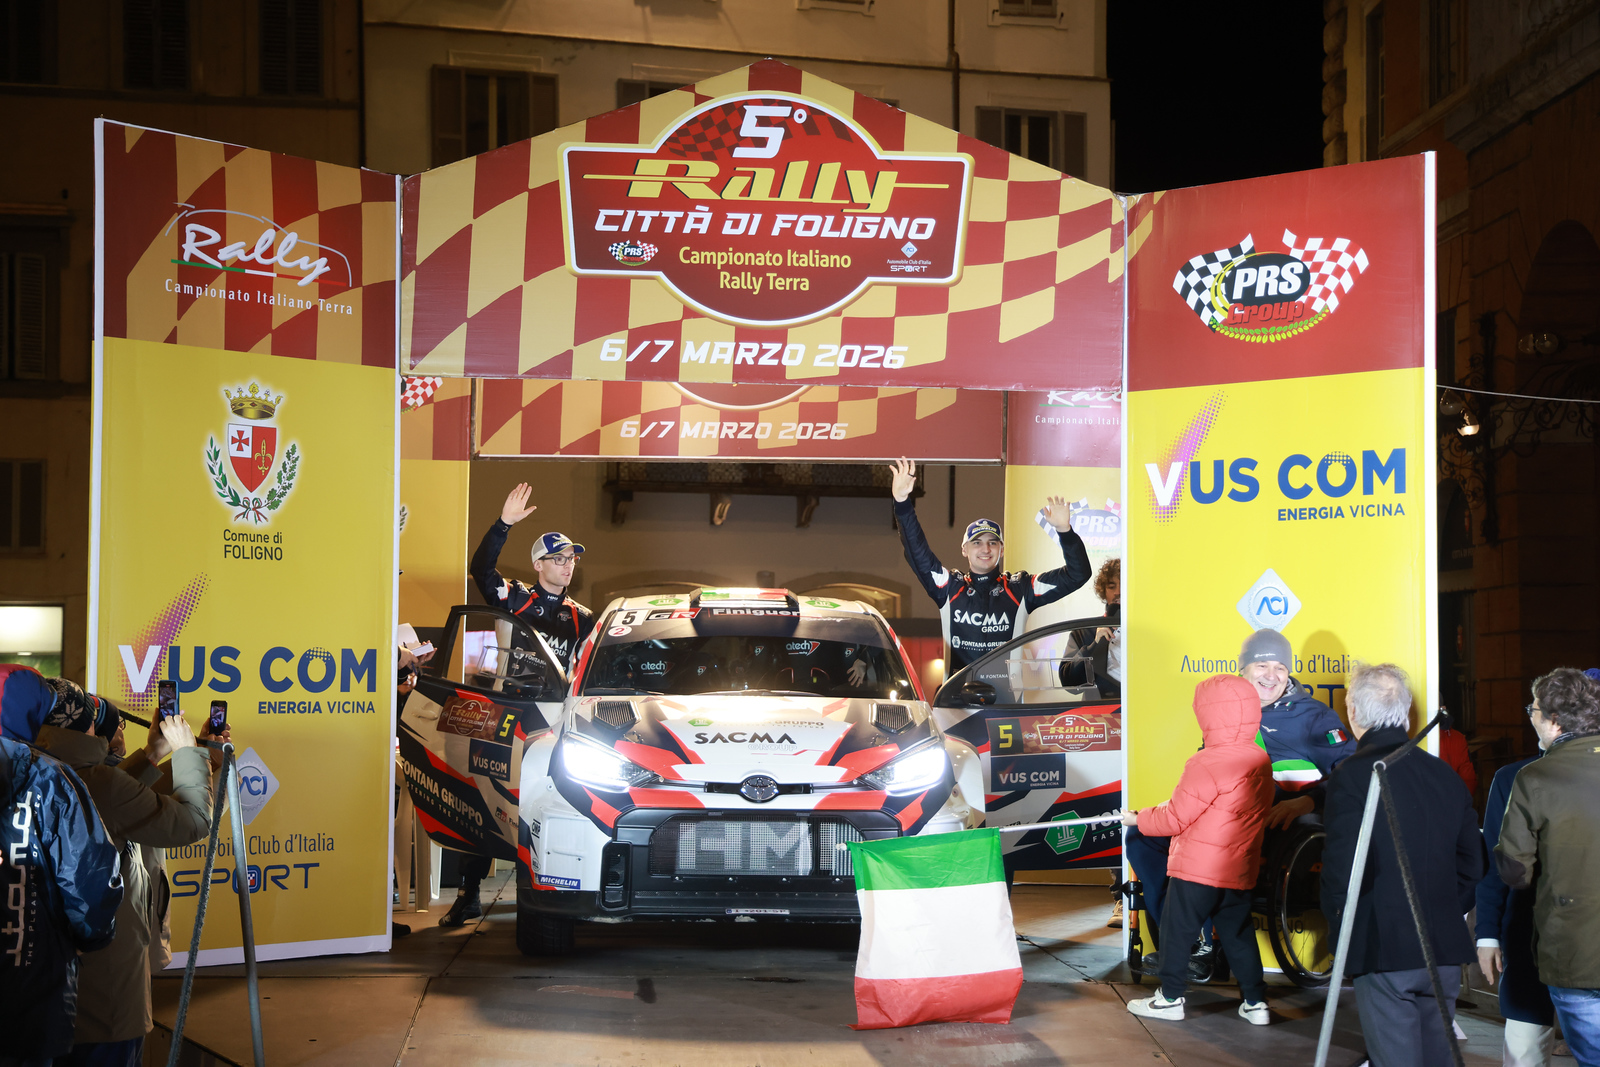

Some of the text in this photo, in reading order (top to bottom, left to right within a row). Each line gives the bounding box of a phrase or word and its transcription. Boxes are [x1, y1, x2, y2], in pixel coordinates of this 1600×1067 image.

[732, 105, 807, 158] 5°
[627, 159, 899, 213] Rally
[595, 205, 936, 240] CITTÀ DI FOLIGNO
[182, 223, 331, 286] Rally
[624, 248, 642, 256] PRS
[679, 247, 851, 269] Campionato Italiano
[720, 272, 809, 295] Rally Terra
[1232, 262, 1305, 300] PRS
[165, 278, 353, 315] Campionato Italiano Terra
[1227, 300, 1304, 324] Group
[599, 339, 908, 369] 6/7 MARZO 2026
[1035, 414, 1121, 426] Campionato Itali
[620, 421, 848, 440] 6/7 MARZO 2026
[1144, 448, 1406, 506] VUS COM
[1278, 503, 1405, 521] ENERGIA VICINA
[1074, 515, 1120, 534] PRS
[223, 529, 283, 544] Comune di
[224, 545, 283, 561] FOLIGNO
[622, 611, 637, 625] 5
[953, 609, 1010, 626] SACMA
[981, 625, 1010, 633] GROUP
[786, 640, 811, 651] atech
[961, 640, 987, 648] FONTANA
[118, 645, 377, 693] VUS COM
[641, 660, 666, 670] atech
[1023, 648, 1066, 671] VU
[1181, 654, 1239, 673] Automo
[258, 701, 376, 714] ENERGIA VICINA
[499, 714, 515, 737] 5
[1049, 726, 1095, 734] Rally
[694, 732, 797, 745] SACMA
[998, 724, 1012, 748] 5
[748, 744, 798, 752] GROUP
[472, 756, 489, 769] VUS
[490, 760, 508, 774] COM
[999, 770, 1060, 784] VUS COM
[439, 804, 451, 818] THE
[441, 787, 484, 826] GRUPPO
[249, 835, 281, 855] Club
[285, 833, 335, 853] d'Italia
[540, 876, 578, 887] MICHELIN
